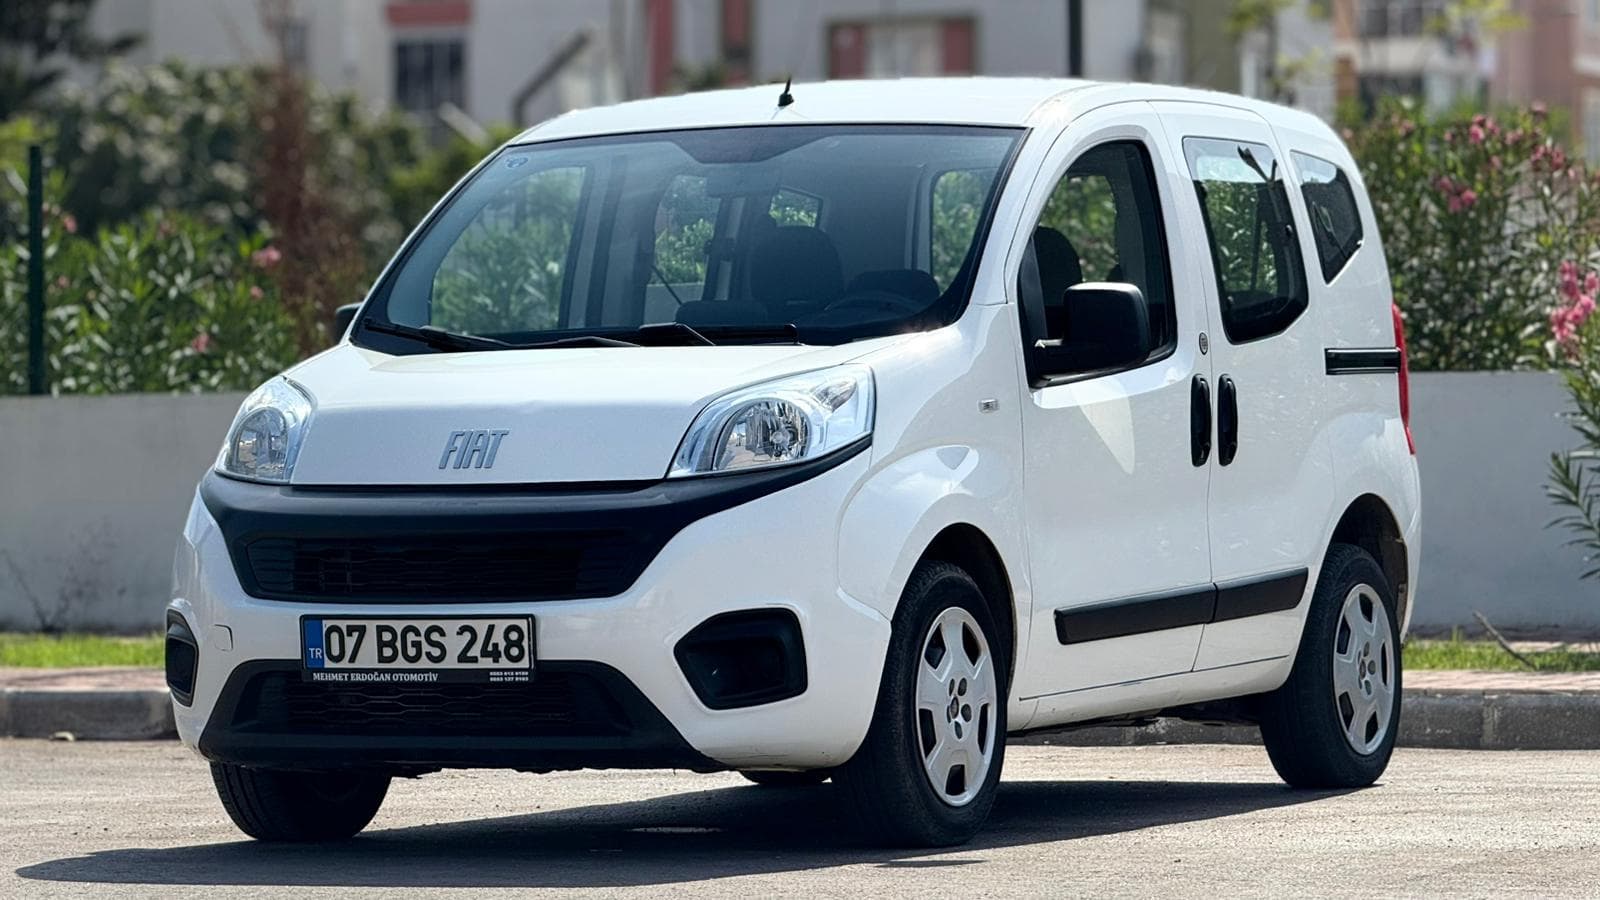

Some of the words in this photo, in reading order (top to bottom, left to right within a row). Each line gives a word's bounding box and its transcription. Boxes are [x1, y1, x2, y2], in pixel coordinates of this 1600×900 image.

[438, 430, 509, 469] FIAT
[309, 648, 322, 659] TR
[325, 625, 366, 664] 07
[376, 625, 447, 664] BGS
[456, 624, 525, 664] 248
[313, 673, 349, 681] MEHMET
[350, 672, 391, 681] ERDOĞAN
[392, 672, 438, 681] OTOMOTİV
